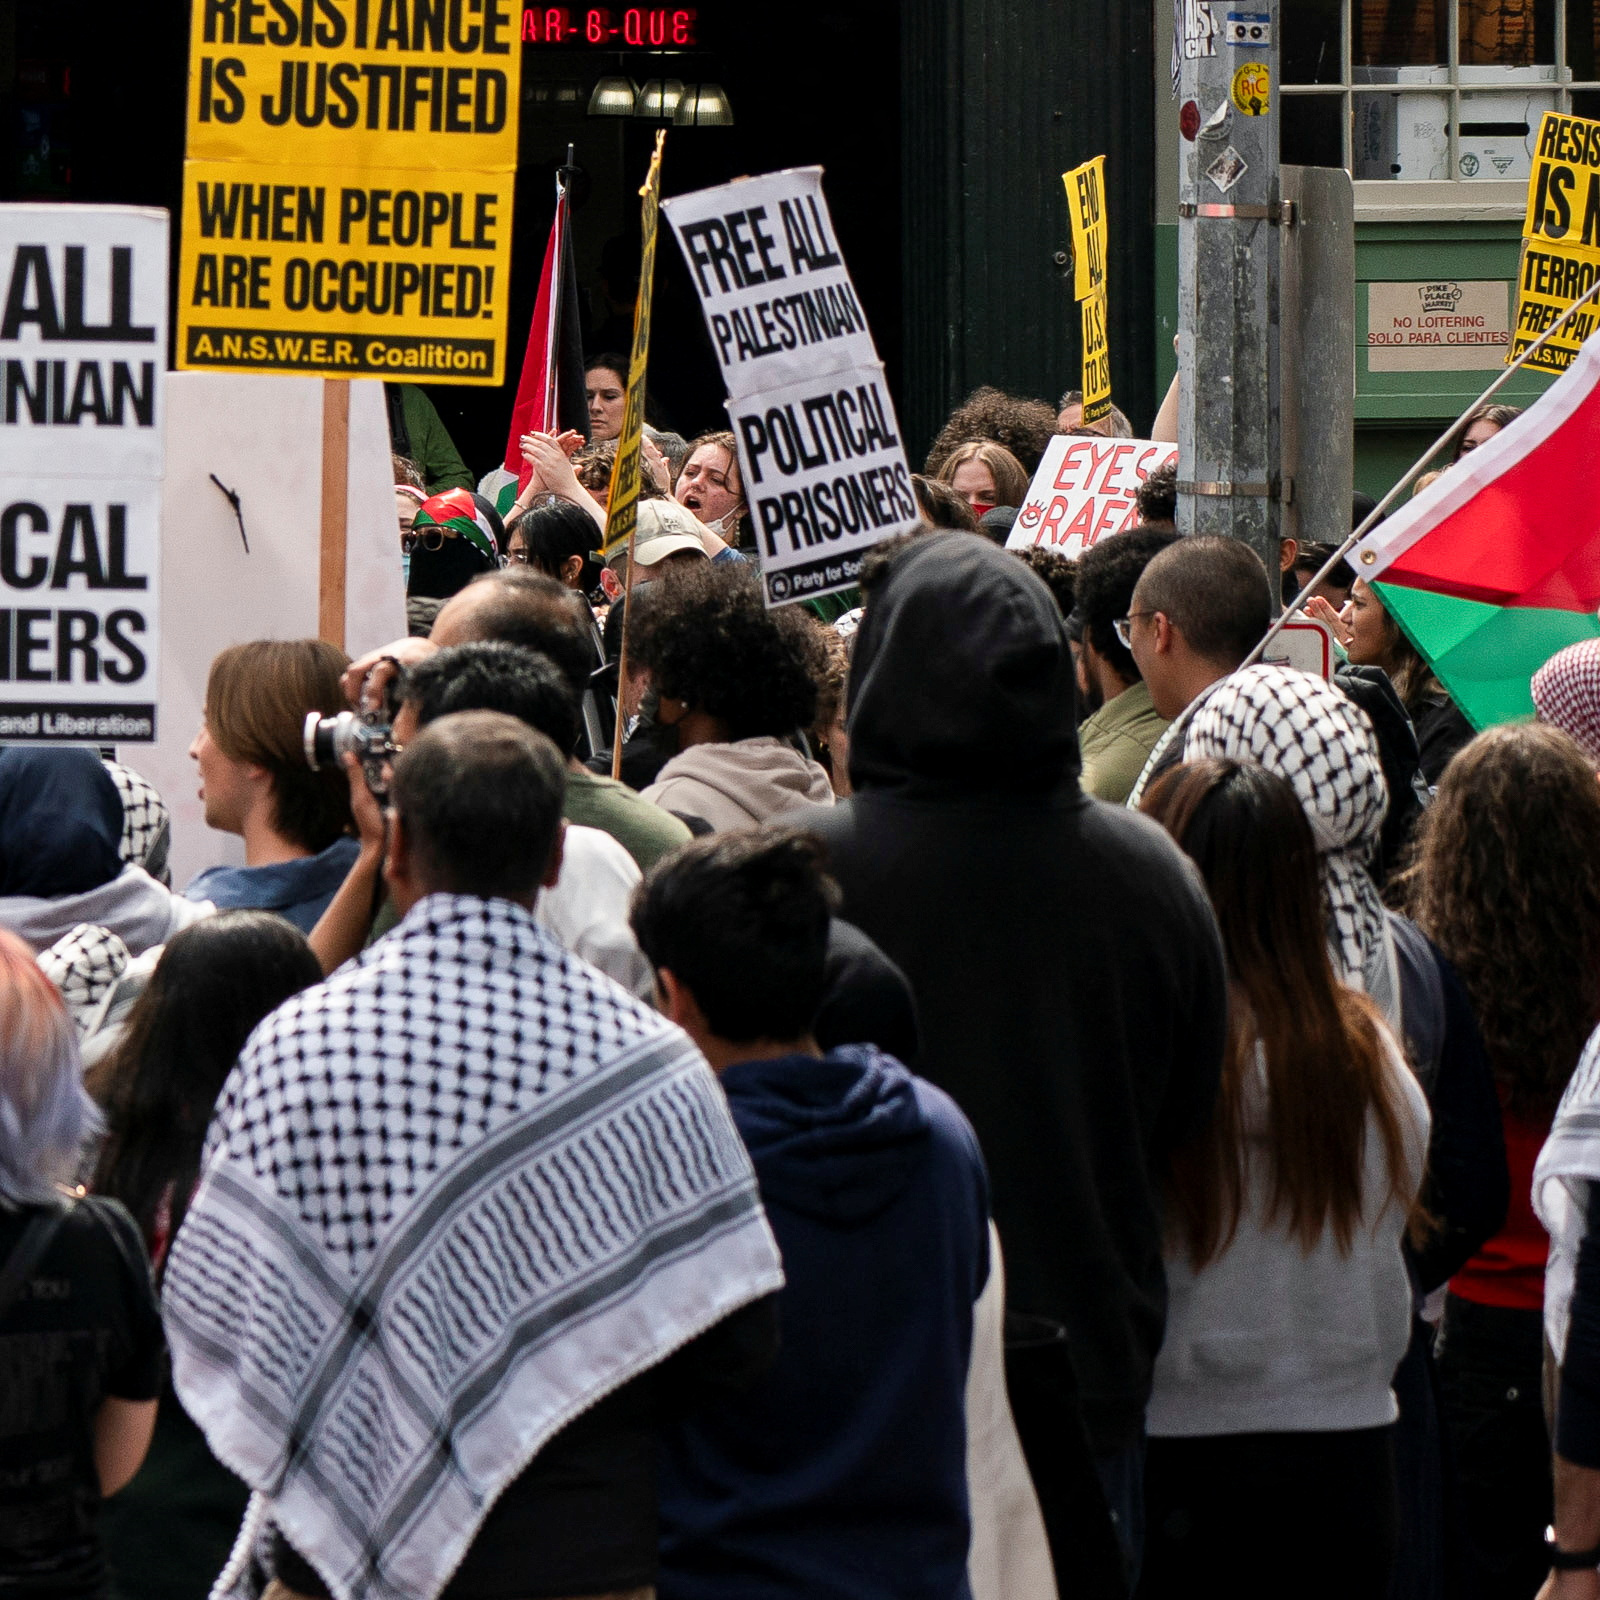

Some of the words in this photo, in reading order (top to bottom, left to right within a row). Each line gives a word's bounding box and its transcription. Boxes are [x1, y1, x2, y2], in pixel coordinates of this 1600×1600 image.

[198, 57, 246, 125] IS
[261, 60, 508, 135] JUSTIFIED
[196, 181, 326, 244] WHEN
[339, 187, 499, 251] PEOPLE
[1076, 166, 1100, 231] END
[1531, 162, 1576, 240] IS
[679, 204, 788, 299] FREE
[779, 193, 842, 276] ALL
[191, 253, 272, 310] ARE
[283, 257, 496, 320] OCCUPIED!
[1424, 291, 1451, 301] PLACE
[1426, 284, 1448, 293] PIKE
[1523, 249, 1600, 307] TERRO
[710, 281, 866, 367] PALESTINIAN
[1367, 332, 1403, 344] SOLO
[1408, 332, 1441, 344] PARA
[1446, 331, 1509, 344] CLIENTES
[1393, 317, 1412, 328] NO
[1418, 316, 1485, 328] LOITERING
[1518, 300, 1564, 337] FREE
[192, 334, 360, 366] A.N.S.W.E.R.
[364, 340, 488, 371] Coalition
[1085, 358, 1098, 398] TO
[737, 381, 899, 485] POLITICAL
[1052, 441, 1158, 499] EYES
[757, 459, 918, 558] PRISONERS
[793, 570, 824, 590] Party
[825, 565, 842, 582] for
[42, 710, 152, 738] Liberation
